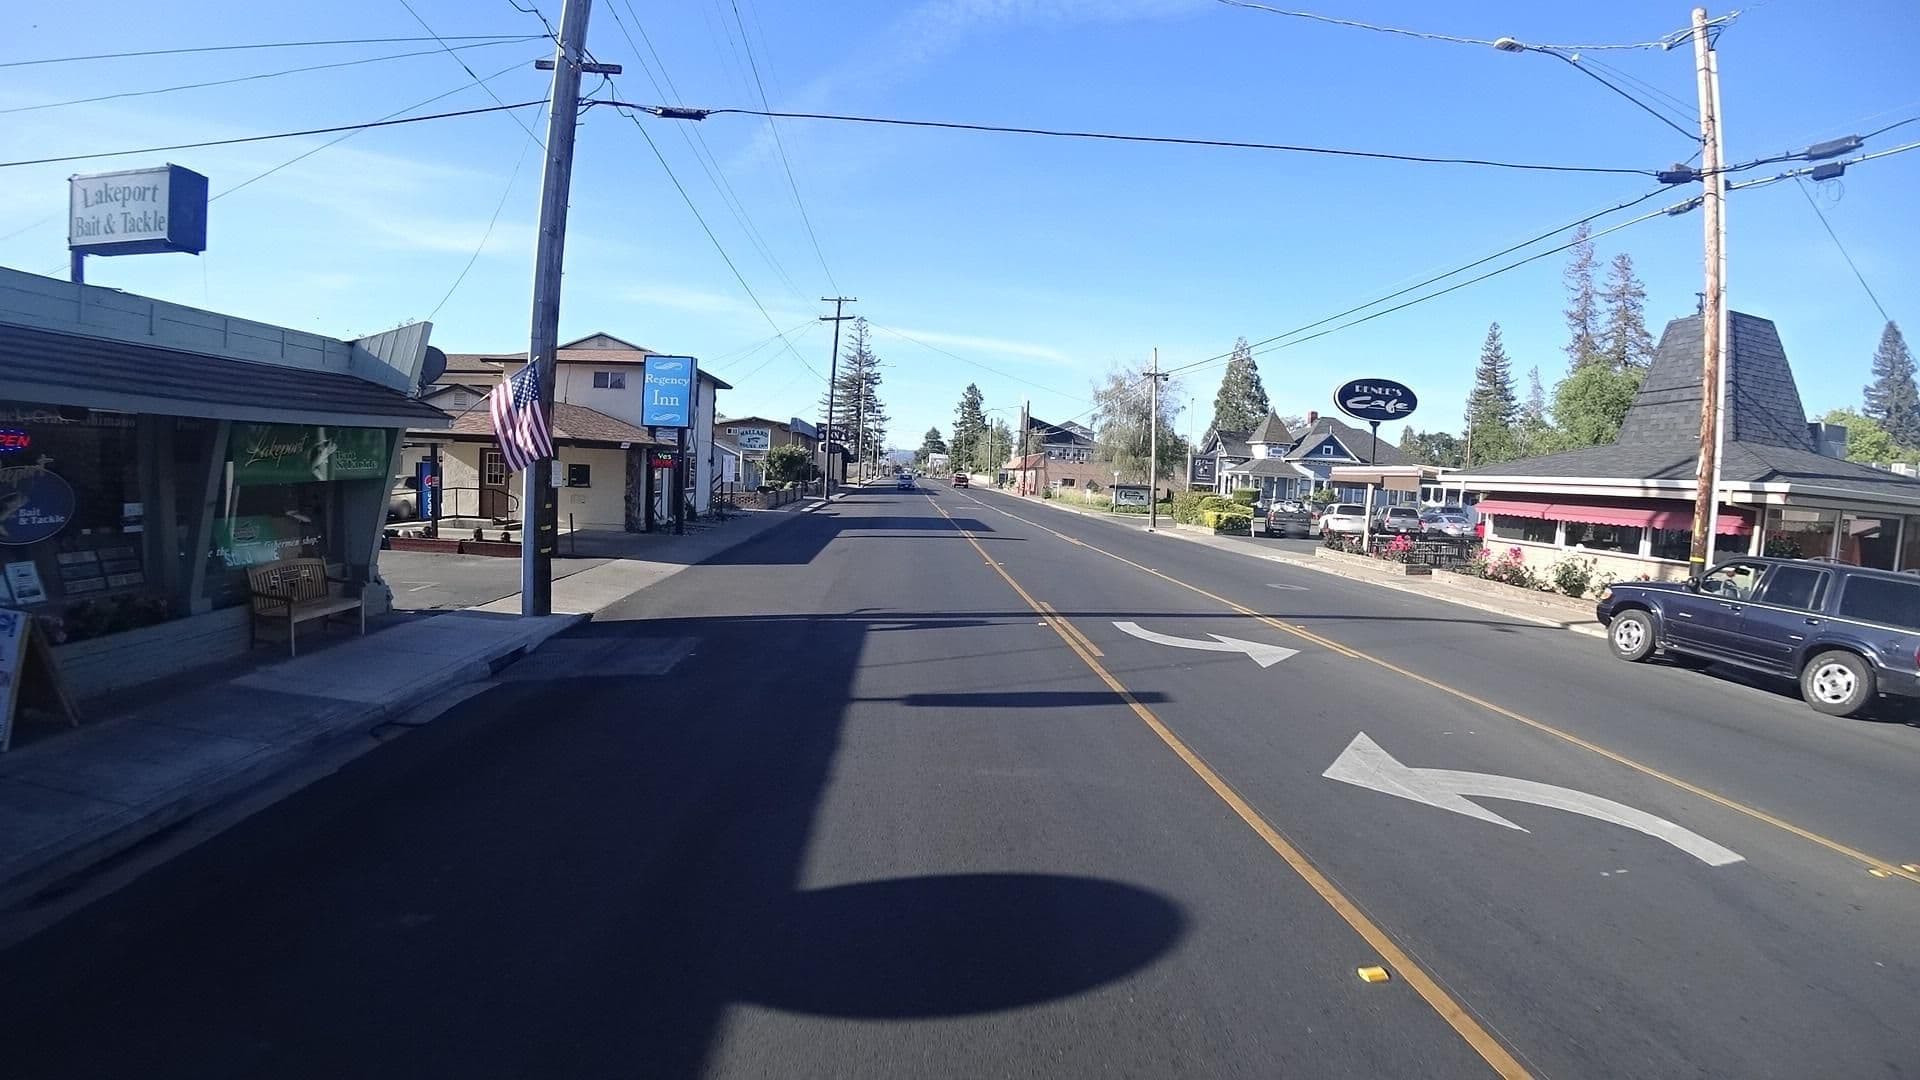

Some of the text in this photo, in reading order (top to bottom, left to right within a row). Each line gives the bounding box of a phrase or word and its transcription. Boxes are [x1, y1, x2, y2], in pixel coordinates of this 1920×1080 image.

[82, 182, 159, 208] Lakeport
[75, 209, 166, 238] Bait & Tackle
[646, 373, 690, 386] Regency
[653, 389, 680, 407] Inn
[30, 514, 65, 525] Tackle
